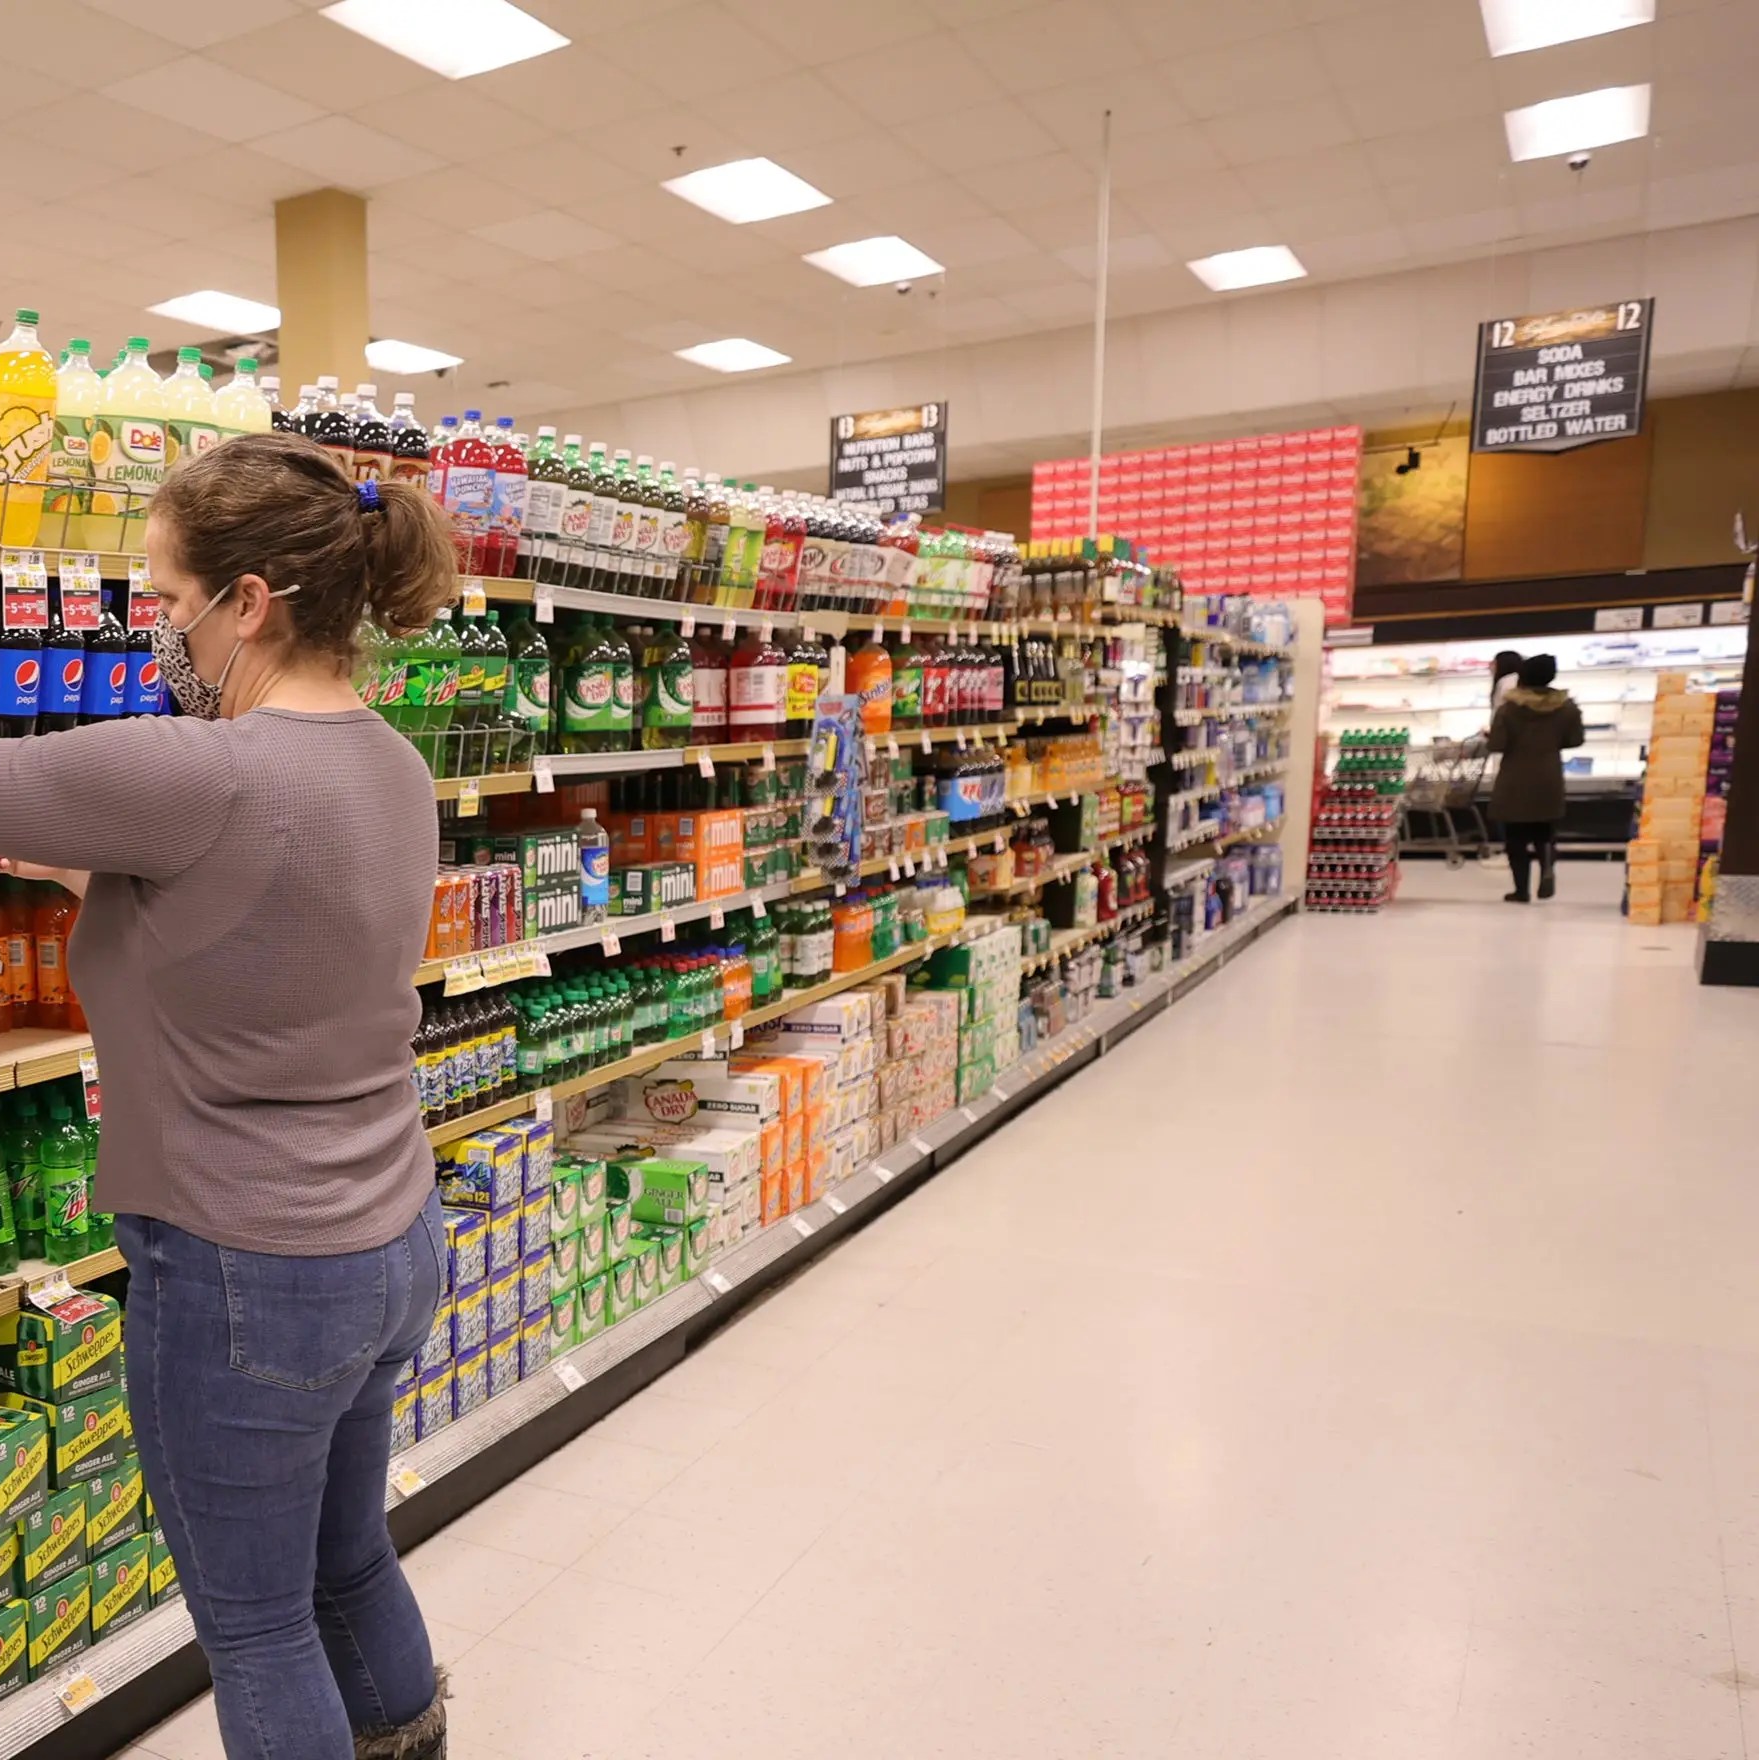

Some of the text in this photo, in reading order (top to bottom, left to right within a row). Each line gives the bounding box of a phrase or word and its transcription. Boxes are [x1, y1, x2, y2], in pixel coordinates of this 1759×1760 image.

[1617, 302, 1641, 331] 12
[1492, 321, 1516, 348] 12
[1538, 344, 1583, 364] SODA
[1513, 360, 1605, 386] BAR MIXES
[1493, 377, 1624, 407] ENERGY DRINKS
[922, 404, 938, 428] 13
[1521, 400, 1591, 422] SELTZER
[838, 416, 854, 439] 13
[1486, 414, 1627, 444] BOTTLED WATER
[67, 437, 87, 450] Dole
[129, 429, 162, 451] Dole
[843, 432, 934, 456] NUTRITION BARS
[838, 447, 936, 473] NUTS & POPCORN
[106, 464, 164, 483] LEMONAD
[863, 466, 908, 485] SNACKS
[711, 818, 739, 849] mini
[538, 835, 578, 875] mini
[661, 865, 694, 902] mini
[711, 860, 739, 890] mini
[539, 886, 578, 928] mini
[791, 1024, 838, 1033] ZERO SUGAR
[645, 1090, 698, 1110] CANADA
[661, 1103, 688, 1117] DRY
[706, 1102, 757, 1113] ZERO SUGAR
[644, 1187, 684, 1199] GINGER
[66, 1327, 115, 1376] Schweppes
[72, 1370, 111, 1389] GINGER ALE
[61, 1406, 75, 1420] 12
[68, 1411, 118, 1461] Schweppes
[75, 1458, 97, 1474] GINGER
